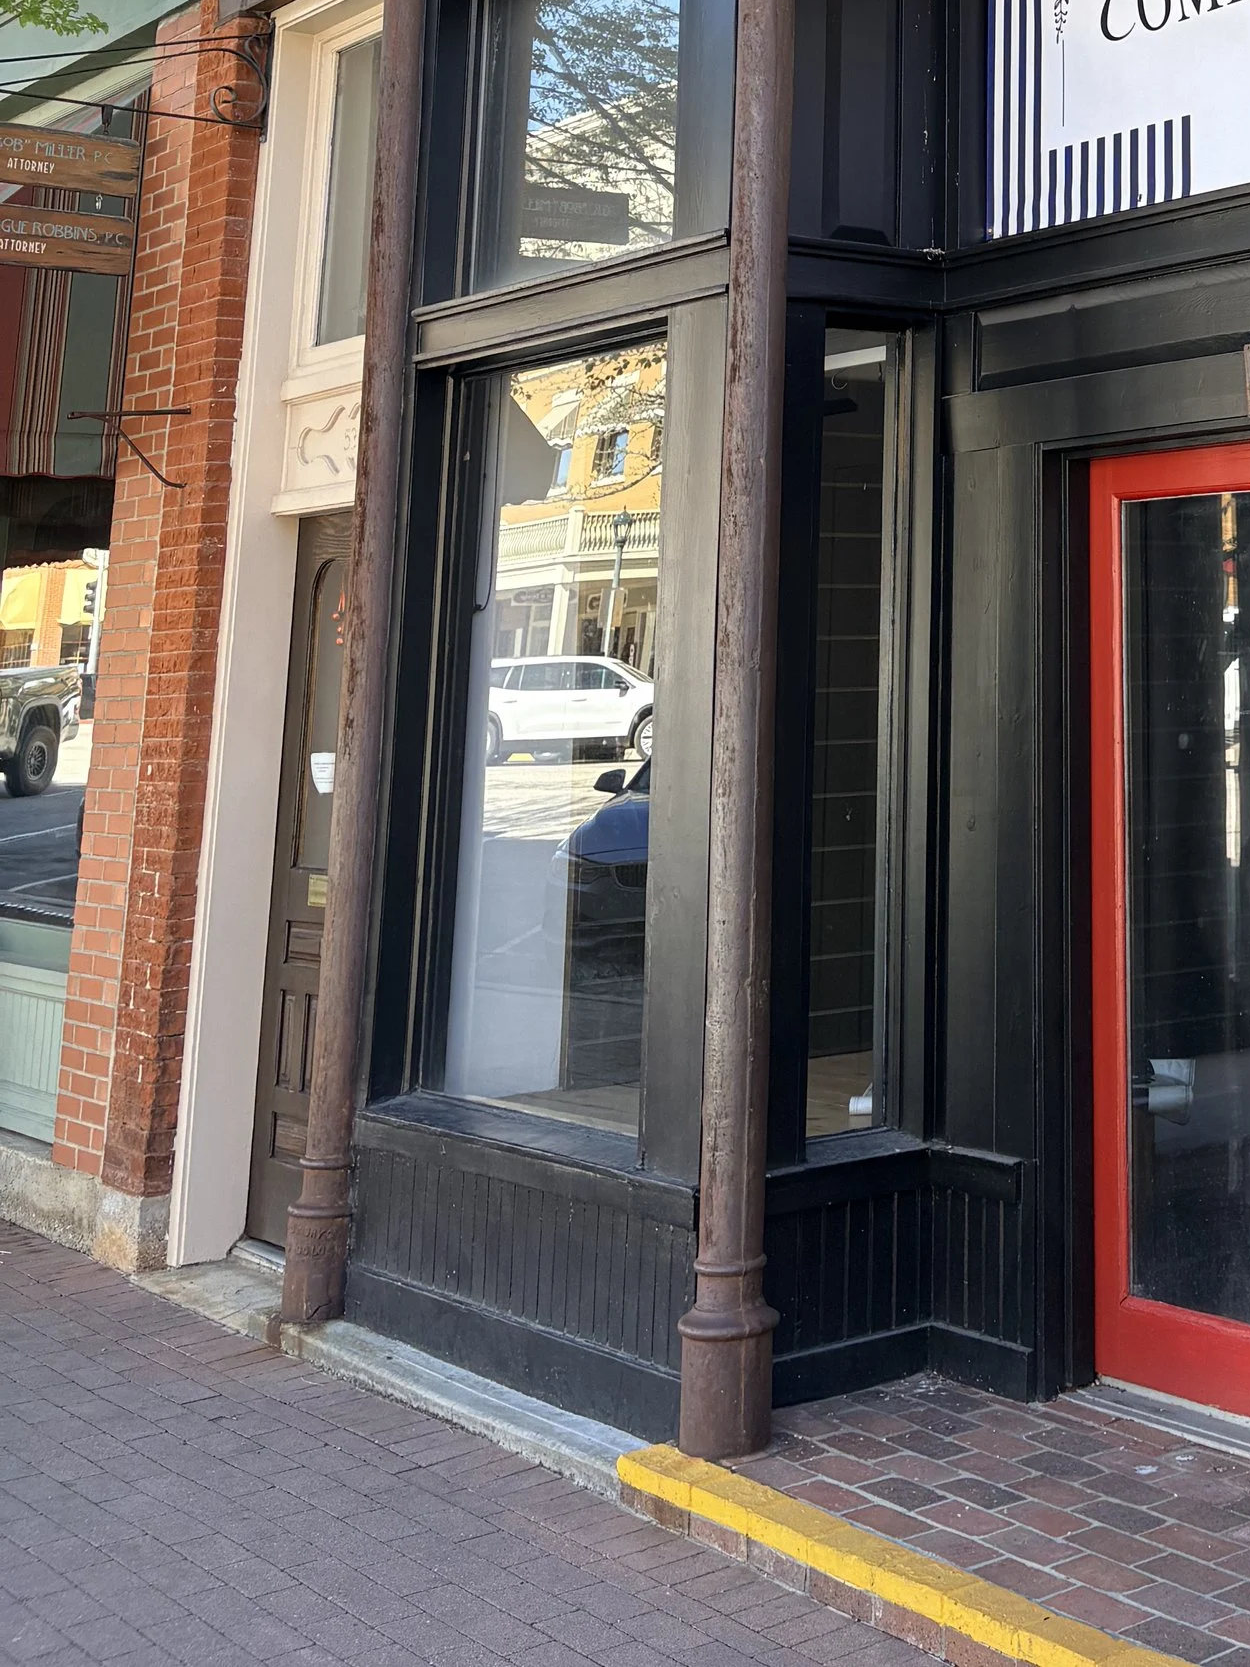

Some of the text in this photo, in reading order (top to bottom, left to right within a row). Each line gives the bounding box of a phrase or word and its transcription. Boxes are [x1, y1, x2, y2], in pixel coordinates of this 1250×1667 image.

[35, 141, 86, 162] MILLER
[7, 157, 55, 174] ATTORNEY
[0, 218, 29, 234] GUE
